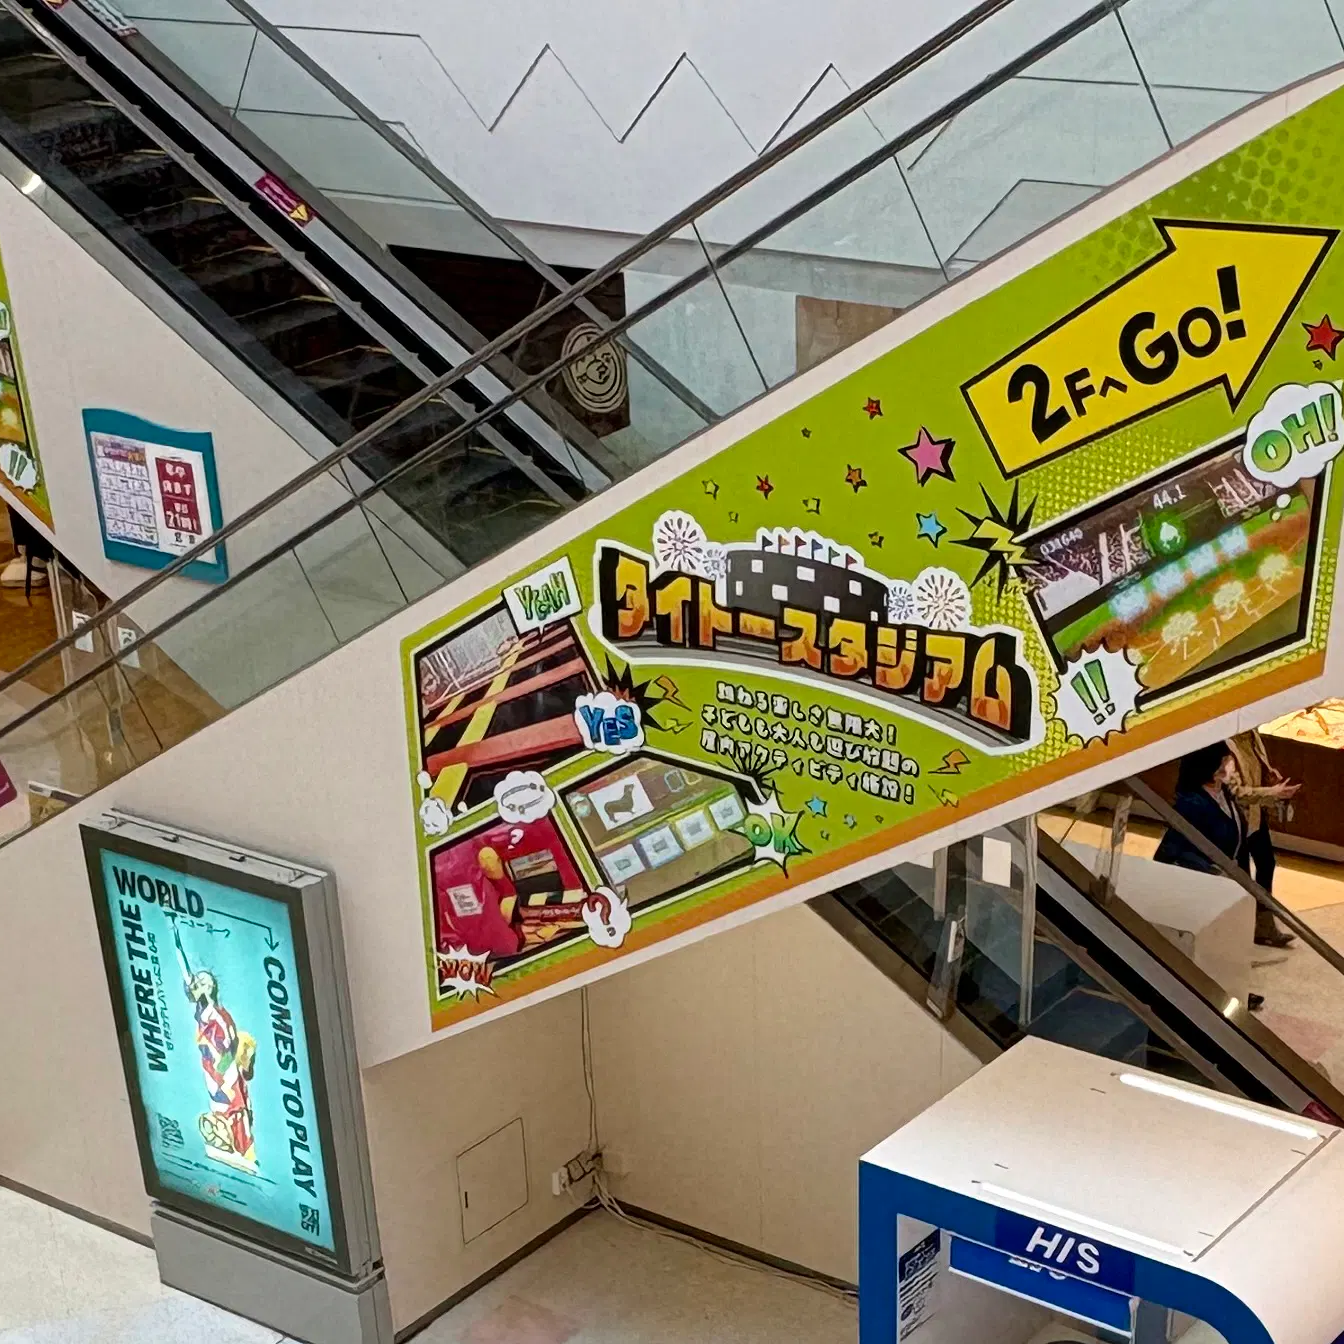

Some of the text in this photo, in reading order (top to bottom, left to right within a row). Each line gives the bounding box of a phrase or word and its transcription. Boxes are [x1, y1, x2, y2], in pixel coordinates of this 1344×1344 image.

[1250, 396, 1340, 474] OH!
[516, 571, 570, 622] YEAH
[599, 545, 1032, 740] タイトースタジアム
[581, 705, 639, 748] YES
[747, 811, 802, 857] OK
[112, 865, 204, 918] WORLD
[119, 899, 149, 962] THE
[439, 958, 494, 988] WOW
[131, 965, 169, 1072] WHERE
[264, 955, 298, 1072] COMES
[281, 1081, 305, 1119] TO
[286, 1119, 318, 1199] PLAY
[1025, 1226, 1101, 1275] HIS
